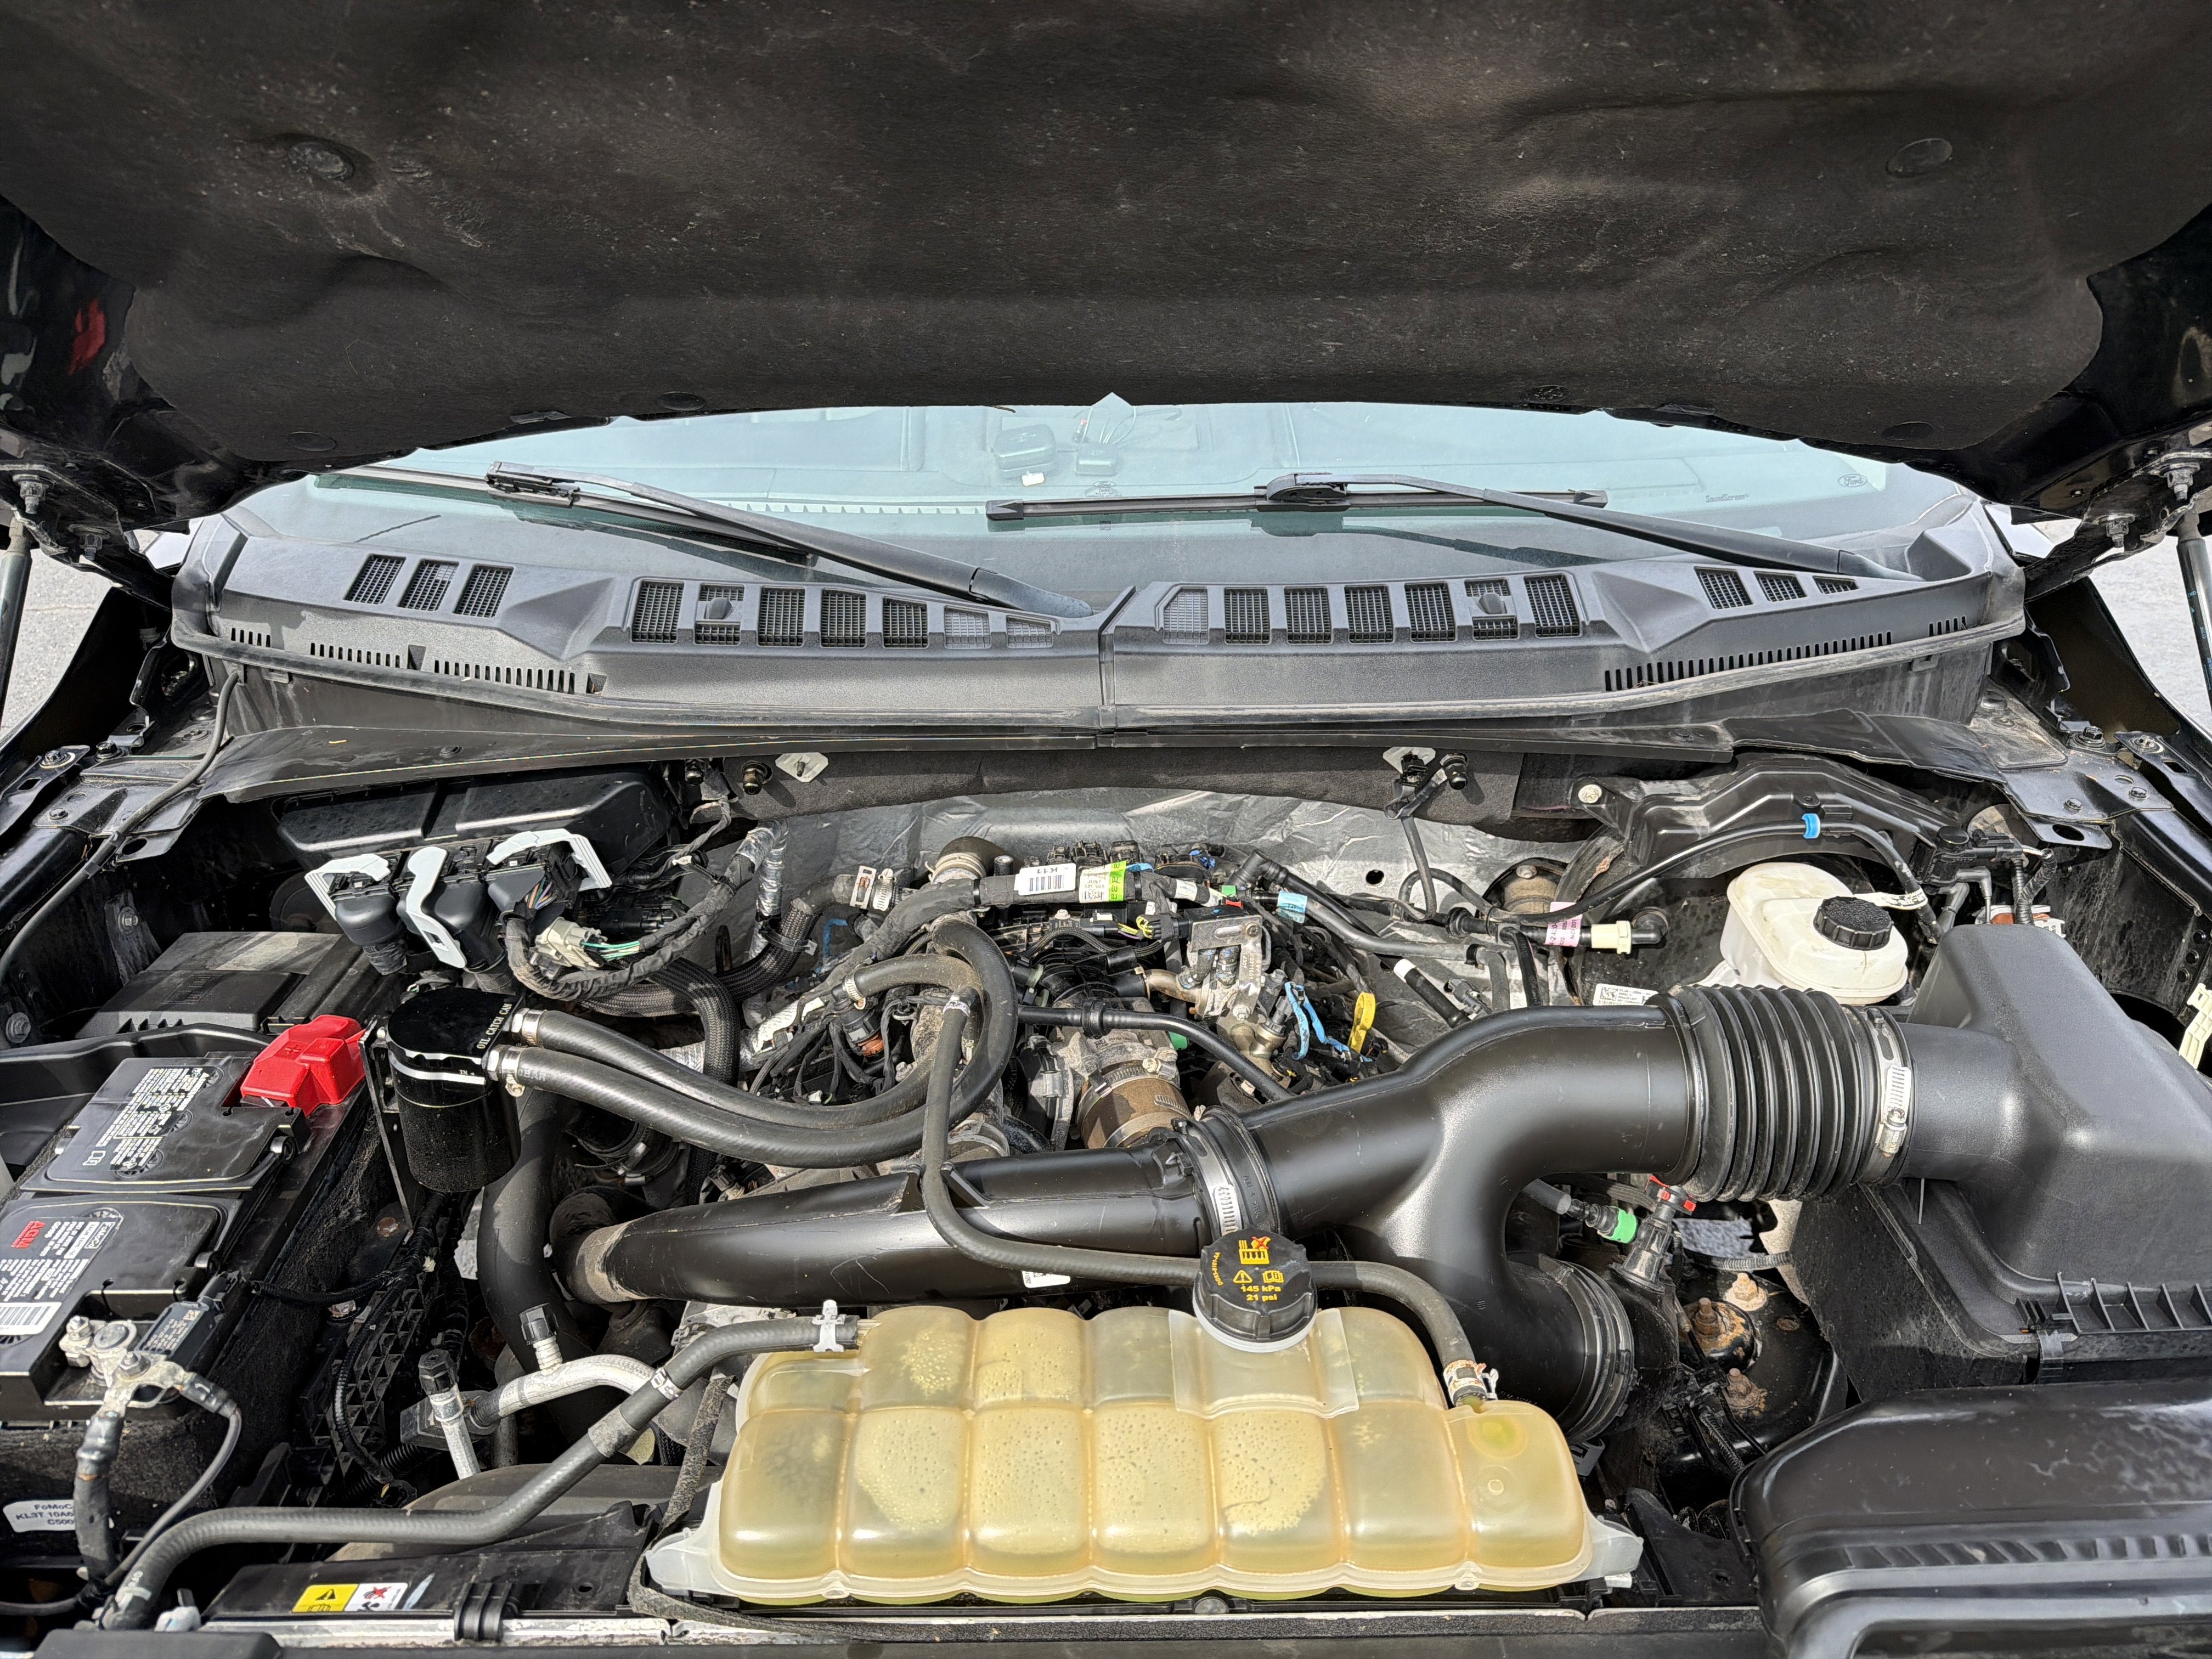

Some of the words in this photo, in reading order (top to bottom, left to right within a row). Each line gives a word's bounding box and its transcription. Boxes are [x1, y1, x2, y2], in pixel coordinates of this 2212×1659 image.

[1843, 475, 1864, 486] Ford
[476, 1037, 491, 1049] OIL
[486, 1017, 505, 1035] CATCH
[499, 1003, 513, 1015] CAN
[16, 1221, 46, 1249] AGM
[88, 1223, 113, 1248] FoMoCo
[1262, 1294, 1278, 1302] psi
